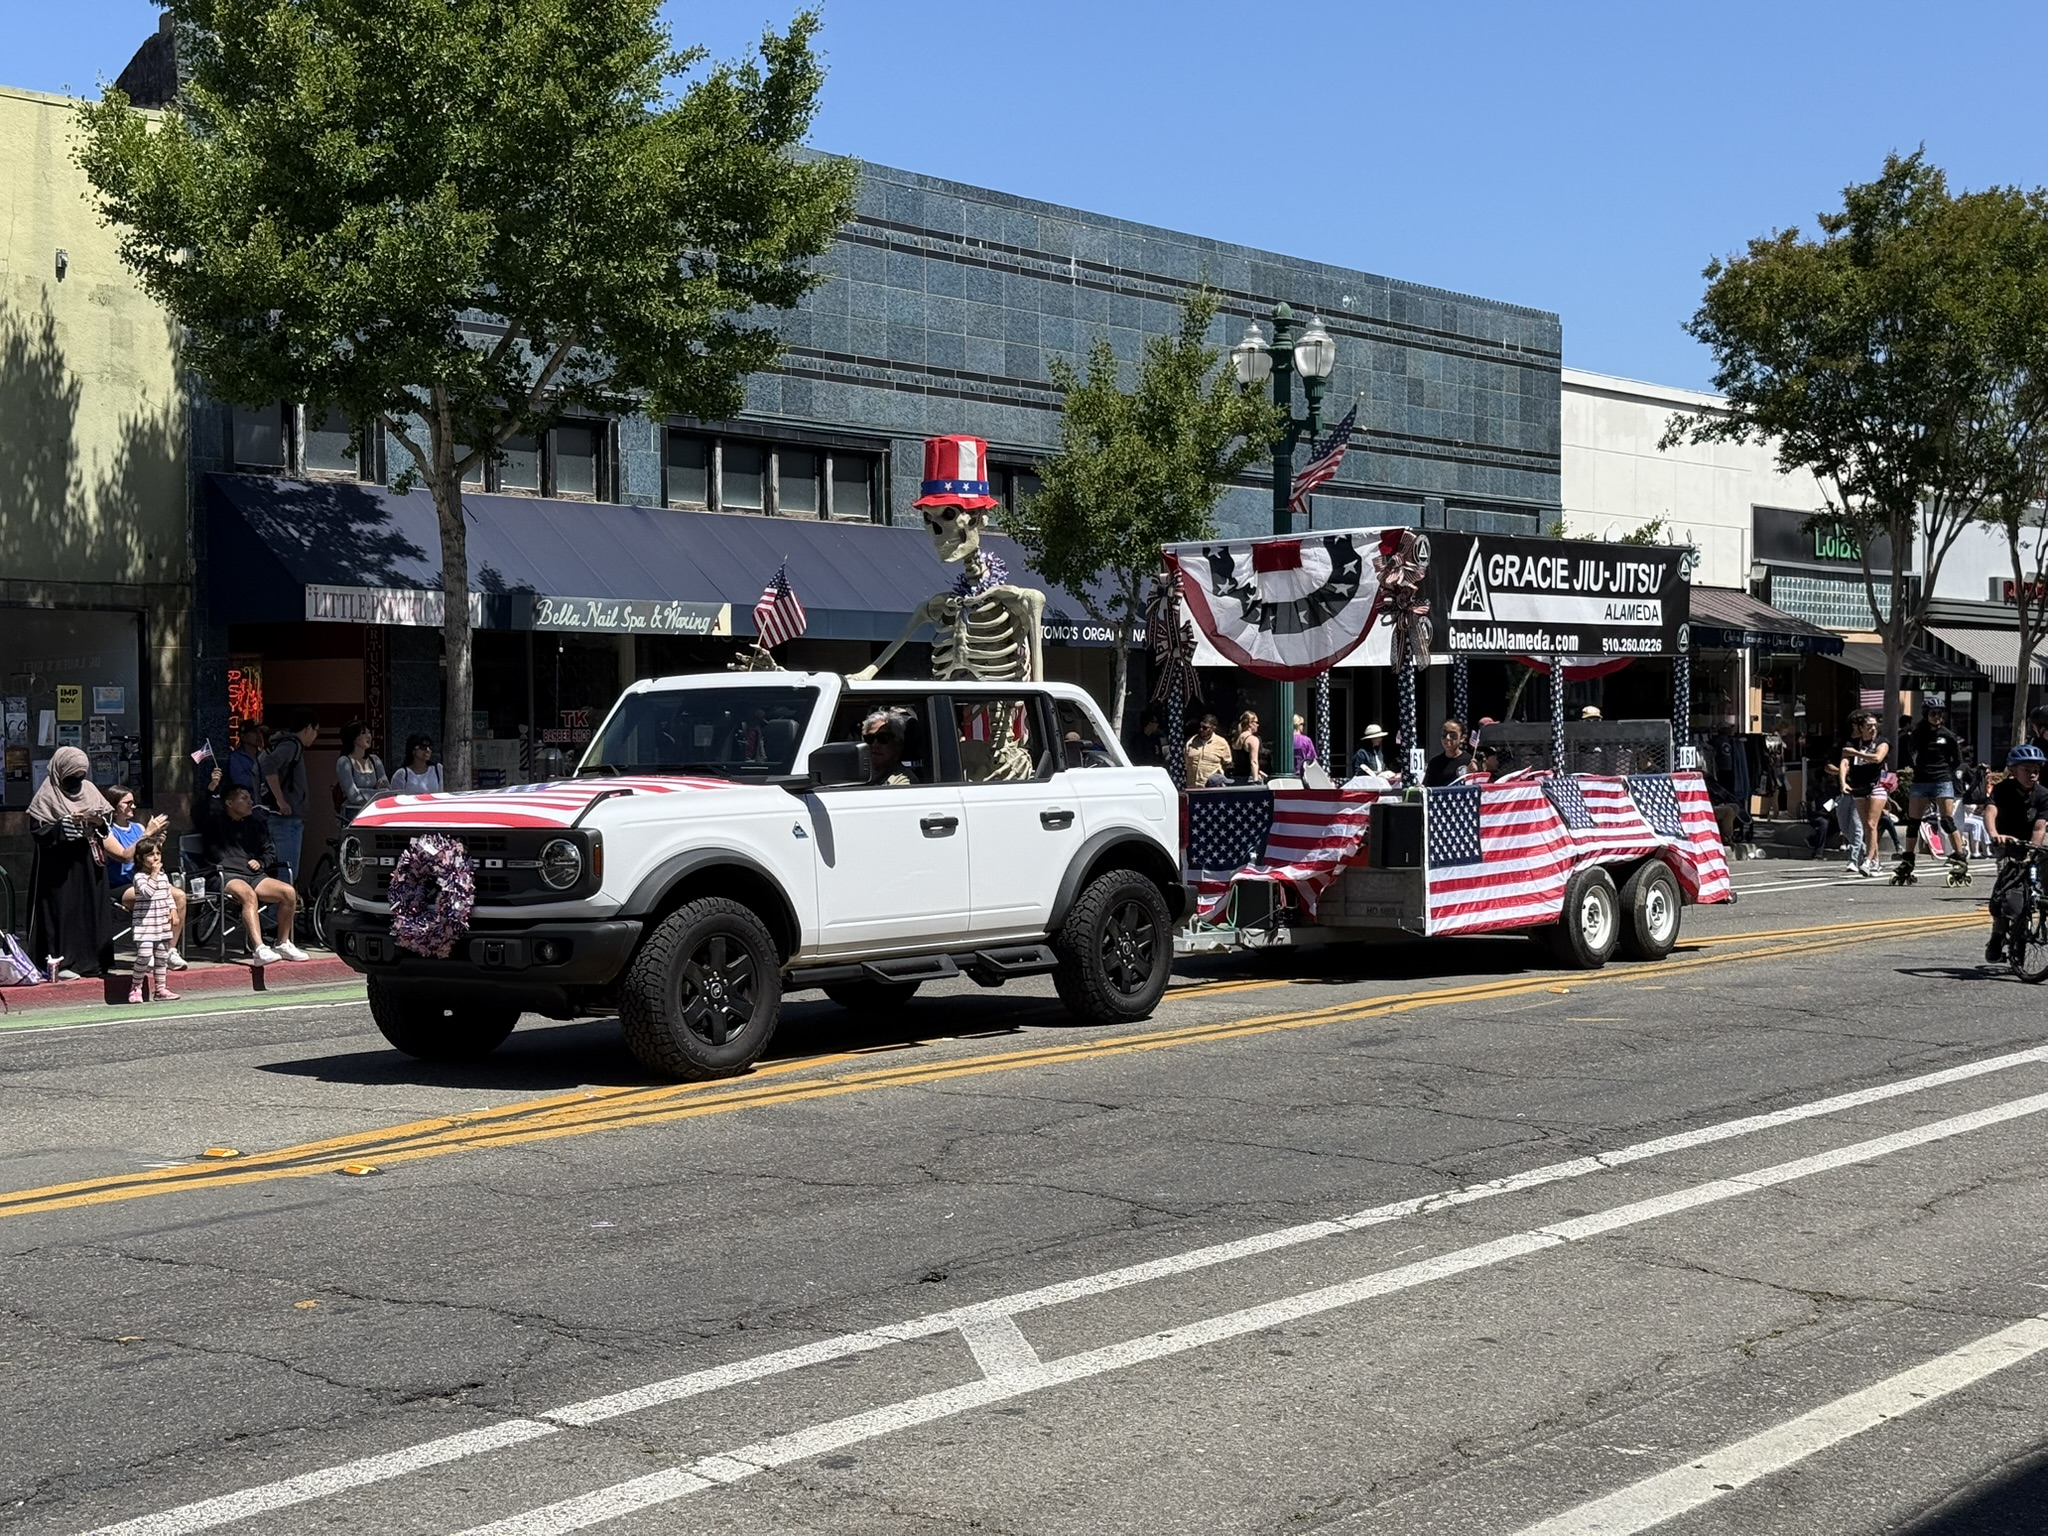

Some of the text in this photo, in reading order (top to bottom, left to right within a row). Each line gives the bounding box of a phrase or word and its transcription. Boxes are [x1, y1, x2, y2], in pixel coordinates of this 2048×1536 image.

[1488, 553, 1569, 590] GRACIE
[1573, 559, 1663, 594] JIU-JITSU
[313, 591, 367, 619] LITTLE
[1604, 603, 1659, 621] ALAMEDA
[536, 599, 711, 635] Bella Nail Spa & Waxing
[1040, 625, 1079, 640] TOMO'S
[1449, 626, 1579, 651] GracieJJAlameda.com
[1602, 638, 1662, 652] 510.260.0226
[60, 688, 78, 697] IMP
[369, 625, 381, 754] RTUNE TELL
[560, 709, 589, 728] TK
[543, 729, 572, 743] BARBER
[572, 729, 592, 742] SHOP
[1681, 749, 1695, 766] 161
